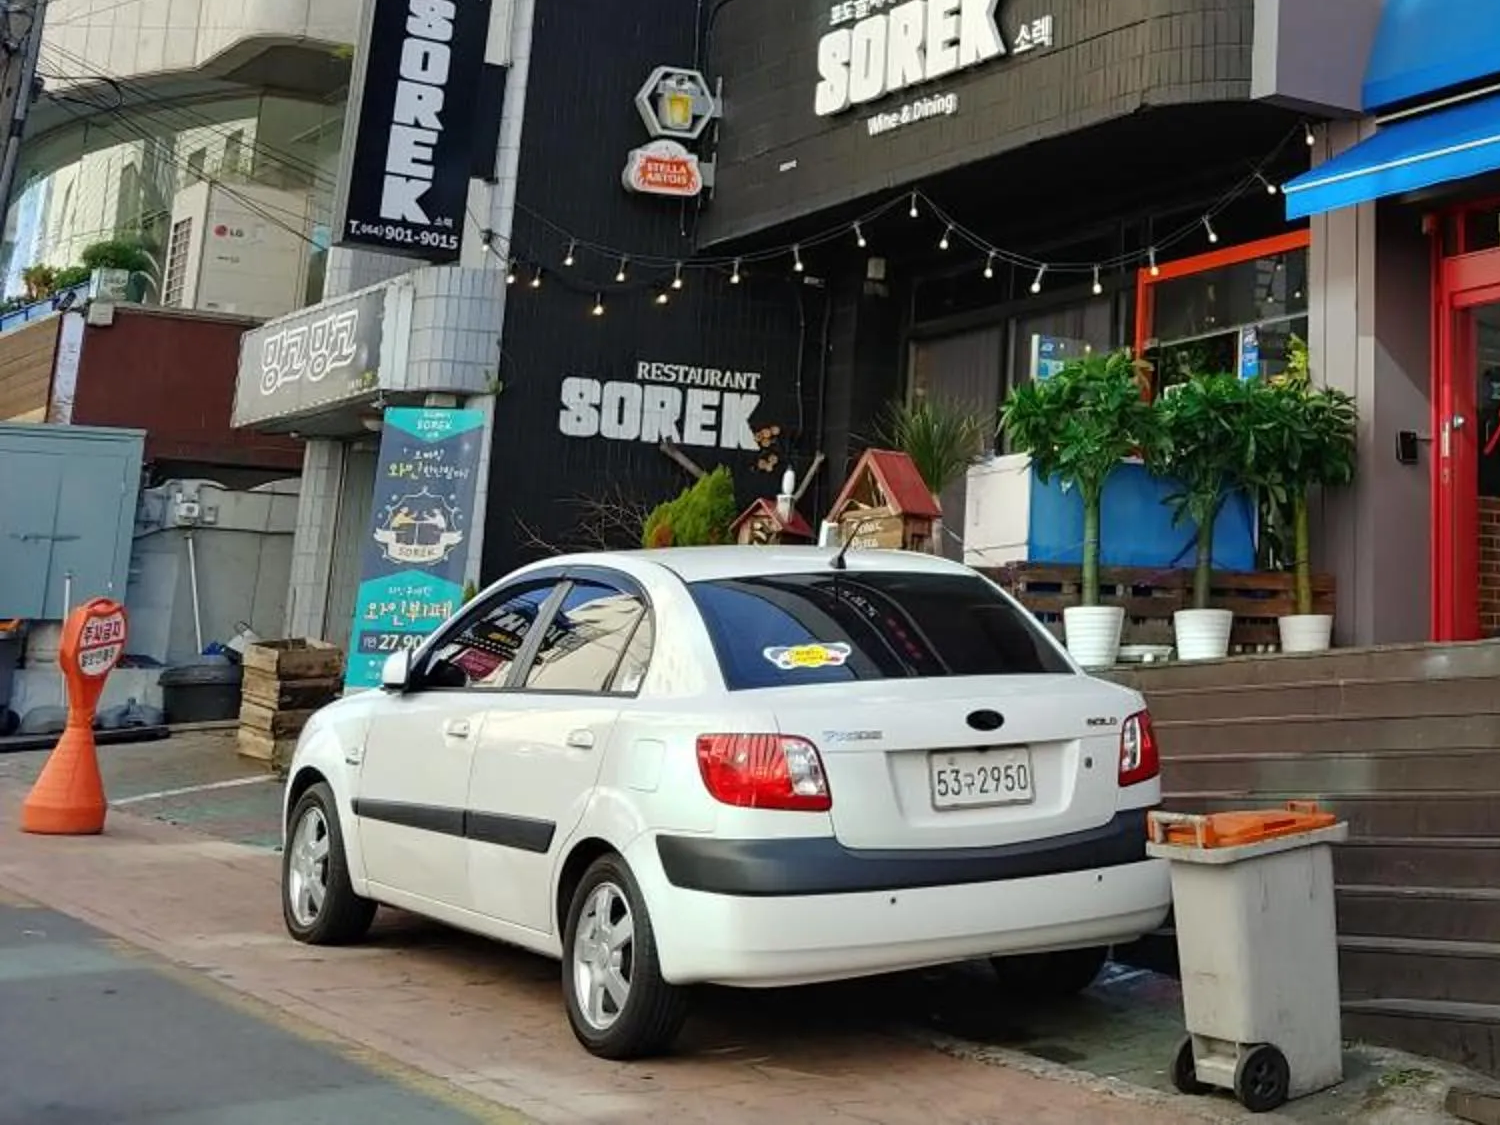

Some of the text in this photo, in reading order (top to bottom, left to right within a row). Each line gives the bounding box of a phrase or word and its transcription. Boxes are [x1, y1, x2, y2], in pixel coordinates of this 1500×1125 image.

[867, 110, 899, 136] Wine
[913, 91, 958, 122] Dining
[385, 224, 459, 250] 901-9015
[637, 361, 761, 390] RESTAURANT
[559, 376, 762, 452] SOREK
